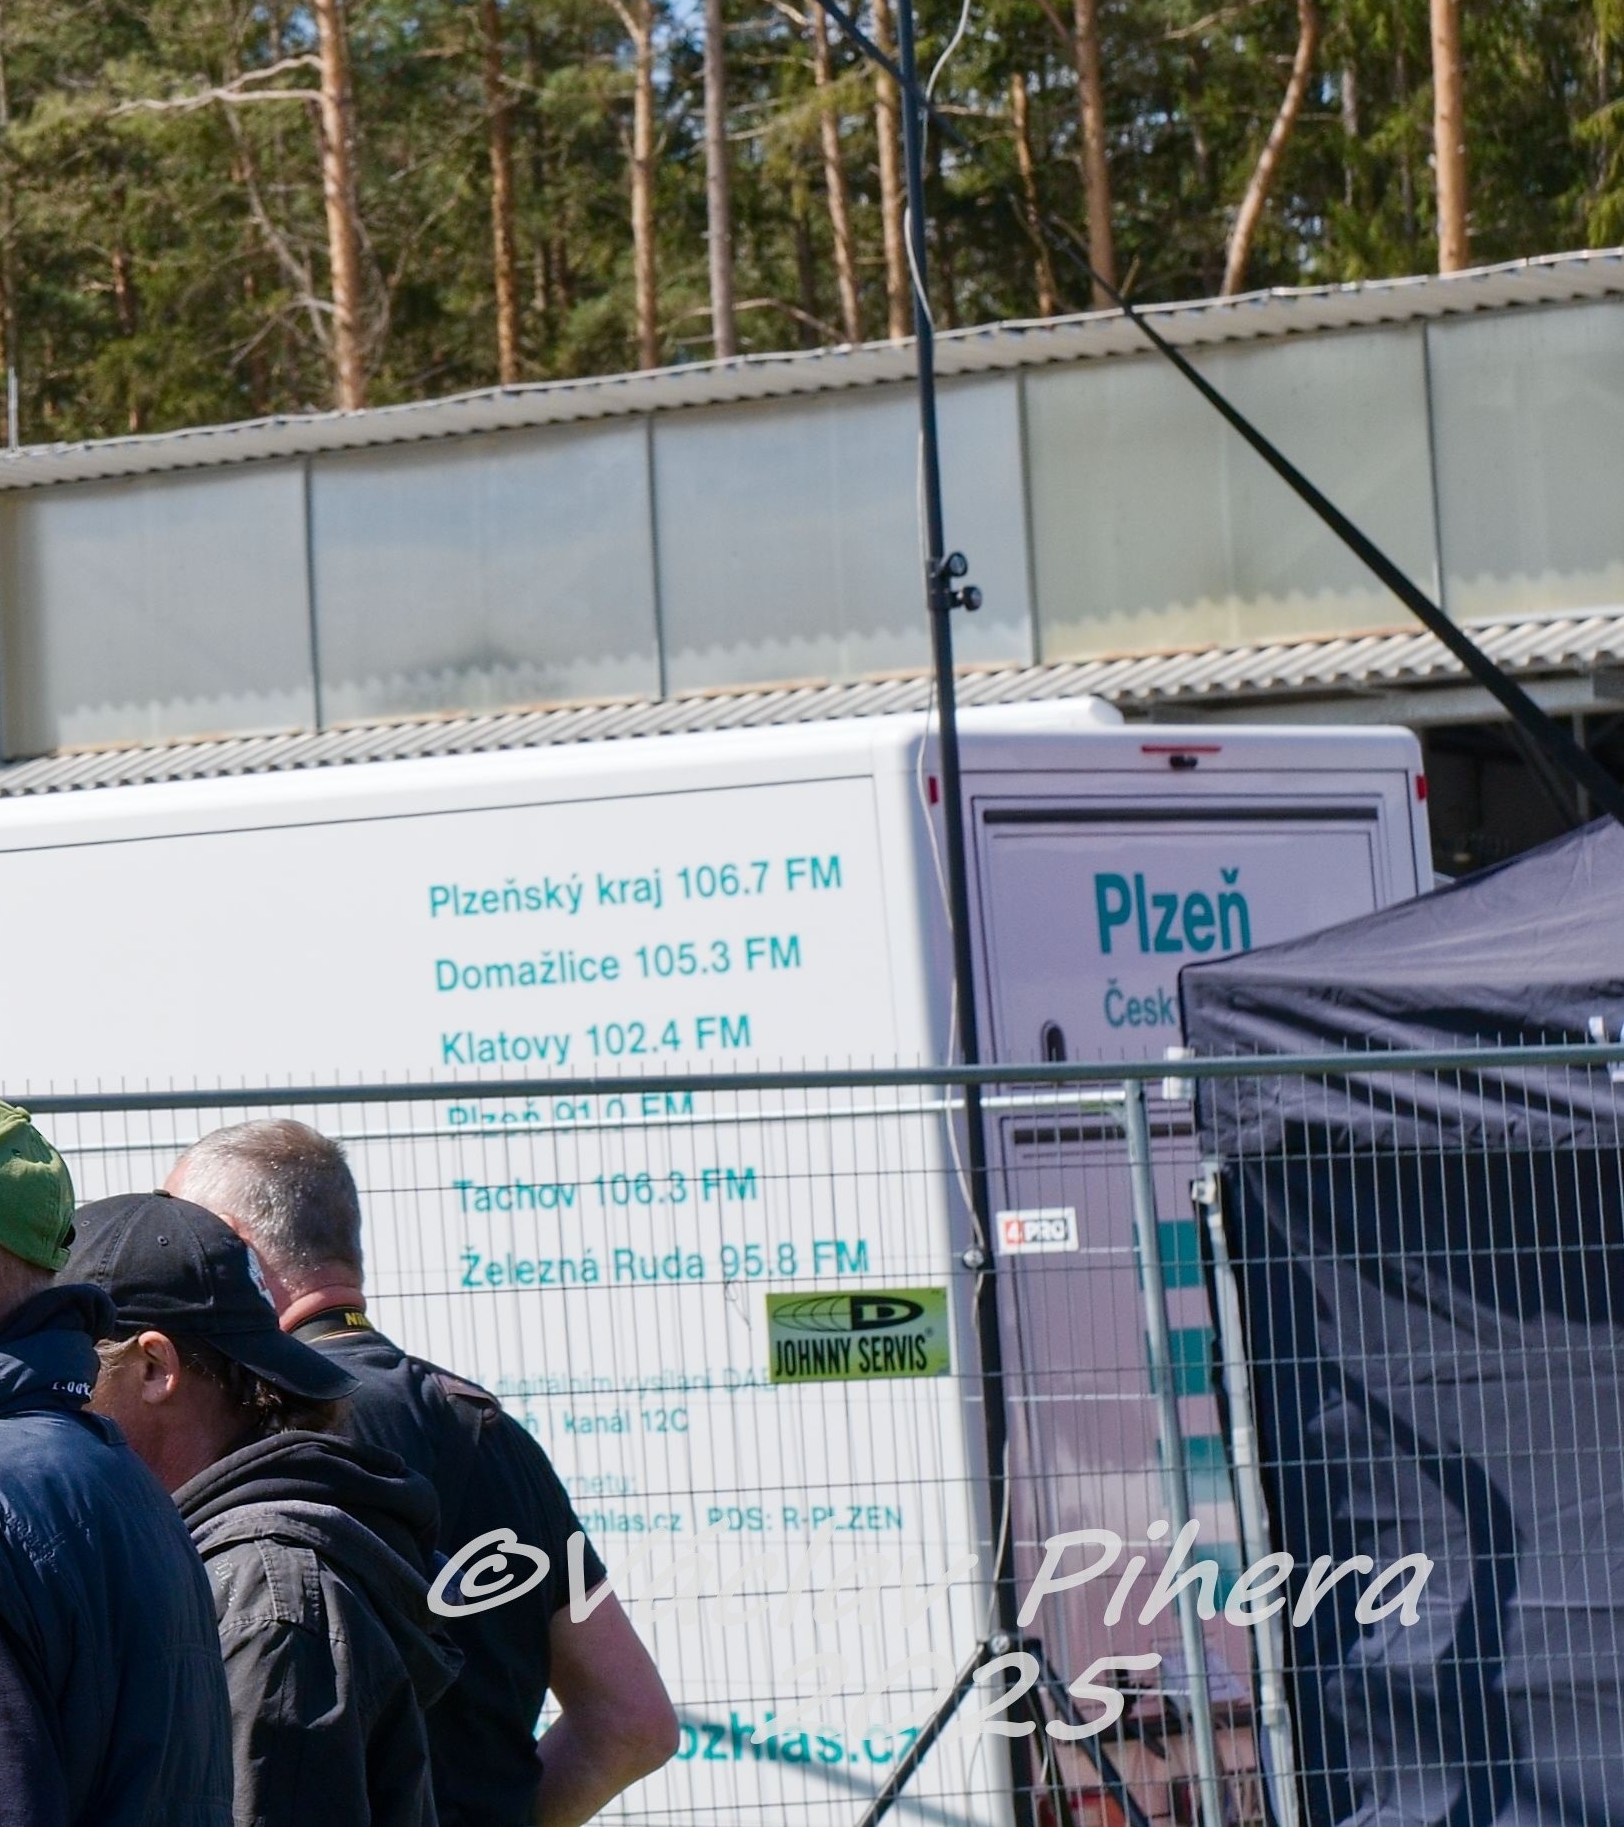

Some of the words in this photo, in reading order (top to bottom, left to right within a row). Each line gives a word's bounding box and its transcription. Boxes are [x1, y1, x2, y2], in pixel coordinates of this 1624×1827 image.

[429, 871, 583, 919] Plzeňský
[596, 870, 664, 909] kraj
[677, 860, 771, 899] 106.7
[785, 854, 843, 891] FM
[1093, 867, 1254, 956] Plzeň
[434, 950, 621, 993] Domažlice
[636, 940, 732, 979] 105.3
[744, 934, 802, 971] FM
[1103, 976, 1178, 1029] Česk
[441, 1030, 571, 1066] Klatovy
[587, 1020, 683, 1057] 102.4
[695, 1014, 752, 1050] FM
[452, 1177, 576, 1214] Tachov
[594, 1170, 689, 1207] 106.3
[701, 1166, 758, 1202] FM
[460, 1246, 600, 1289] Železná
[613, 1246, 705, 1283] Ruda
[721, 1241, 798, 1279] 95.8
[812, 1238, 870, 1275] FM
[776, 1337, 852, 1377] JOHNNY
[858, 1333, 928, 1374] SERVIS
[562, 1408, 631, 1436] kanál
